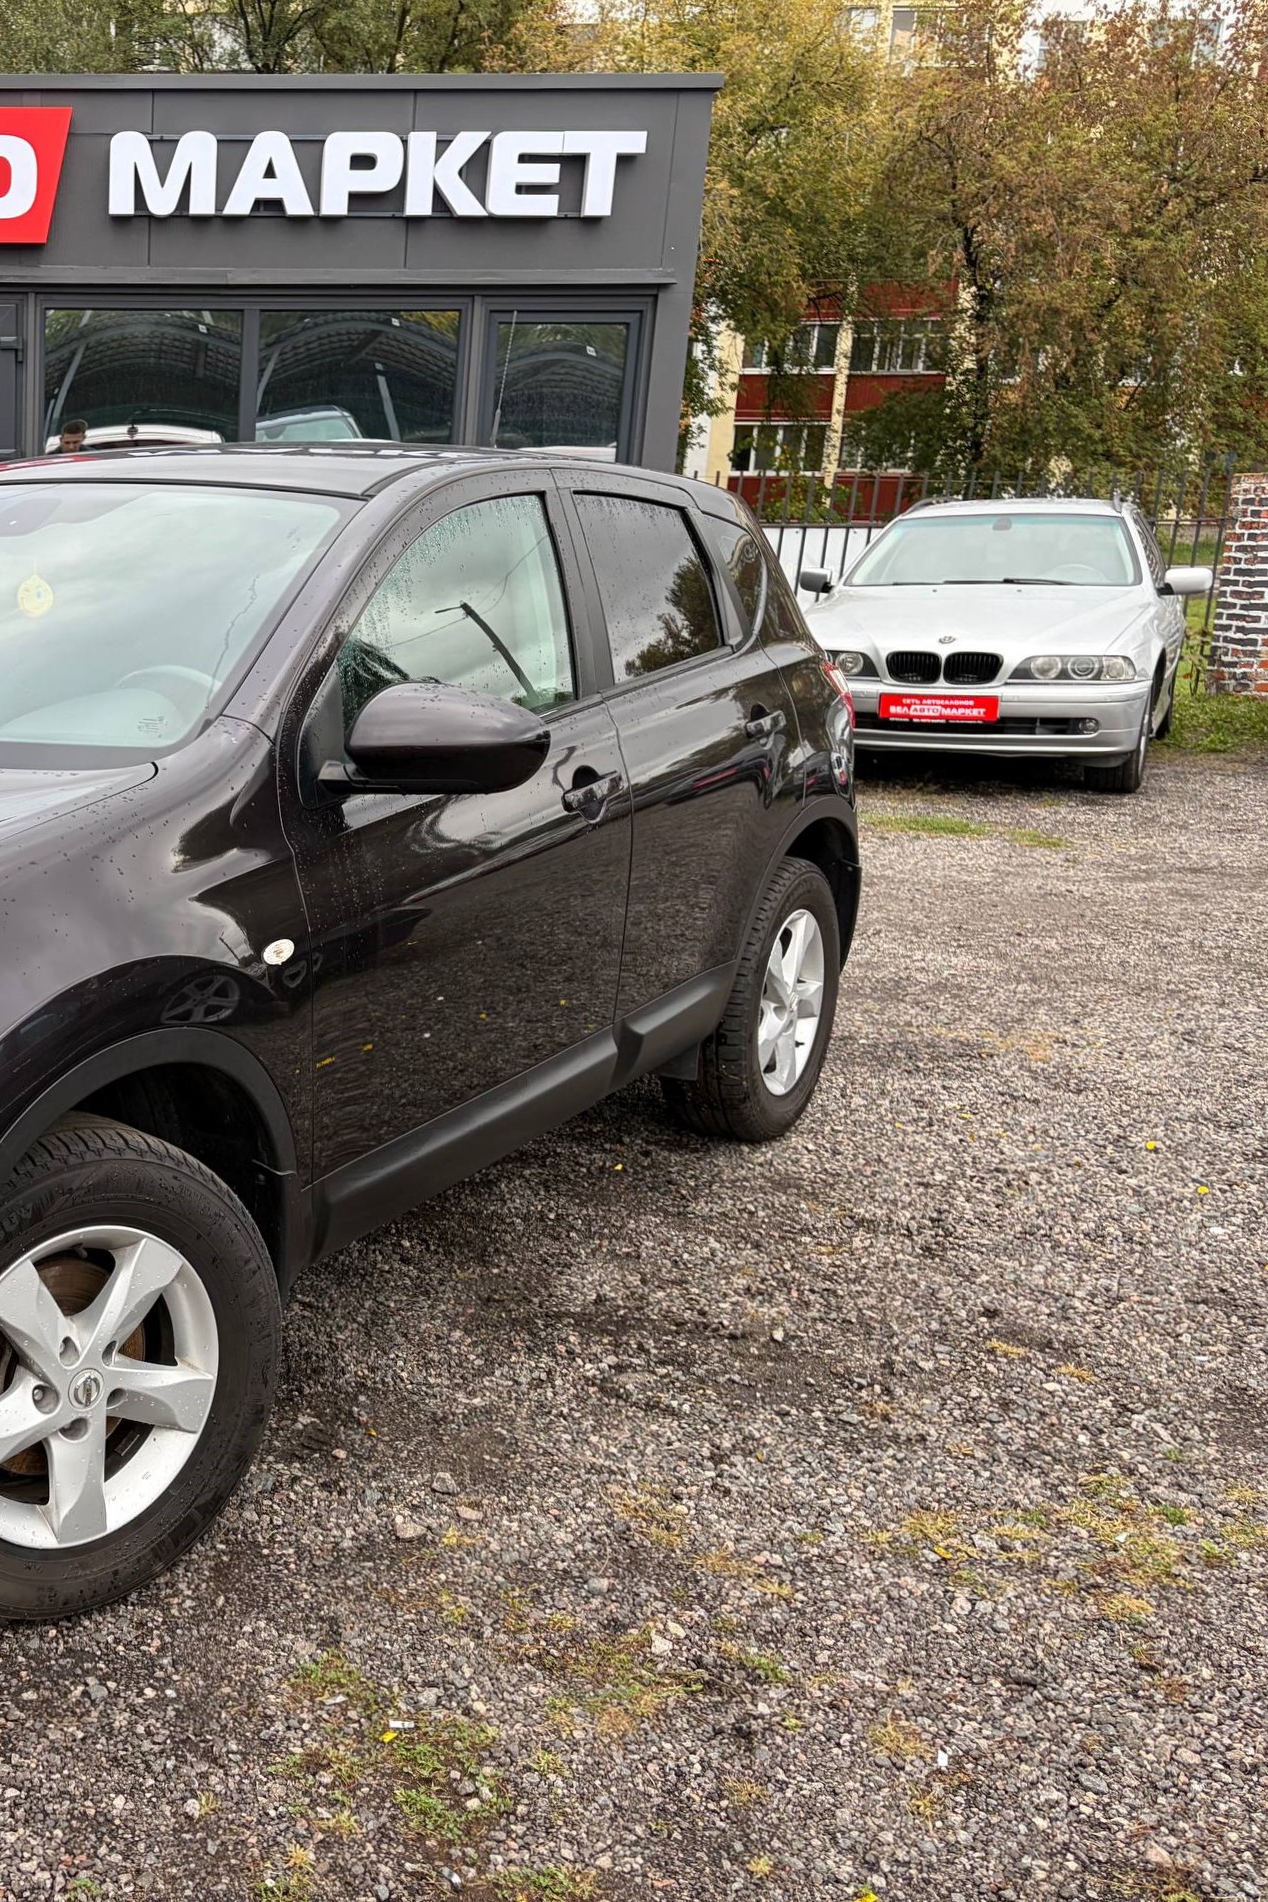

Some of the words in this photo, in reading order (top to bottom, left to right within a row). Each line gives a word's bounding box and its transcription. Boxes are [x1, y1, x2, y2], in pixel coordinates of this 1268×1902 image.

[108, 130, 648, 218] МАРКЕТ
[912, 706, 940, 715] АВТО
[941, 707, 986, 716] МАРКЕТ
